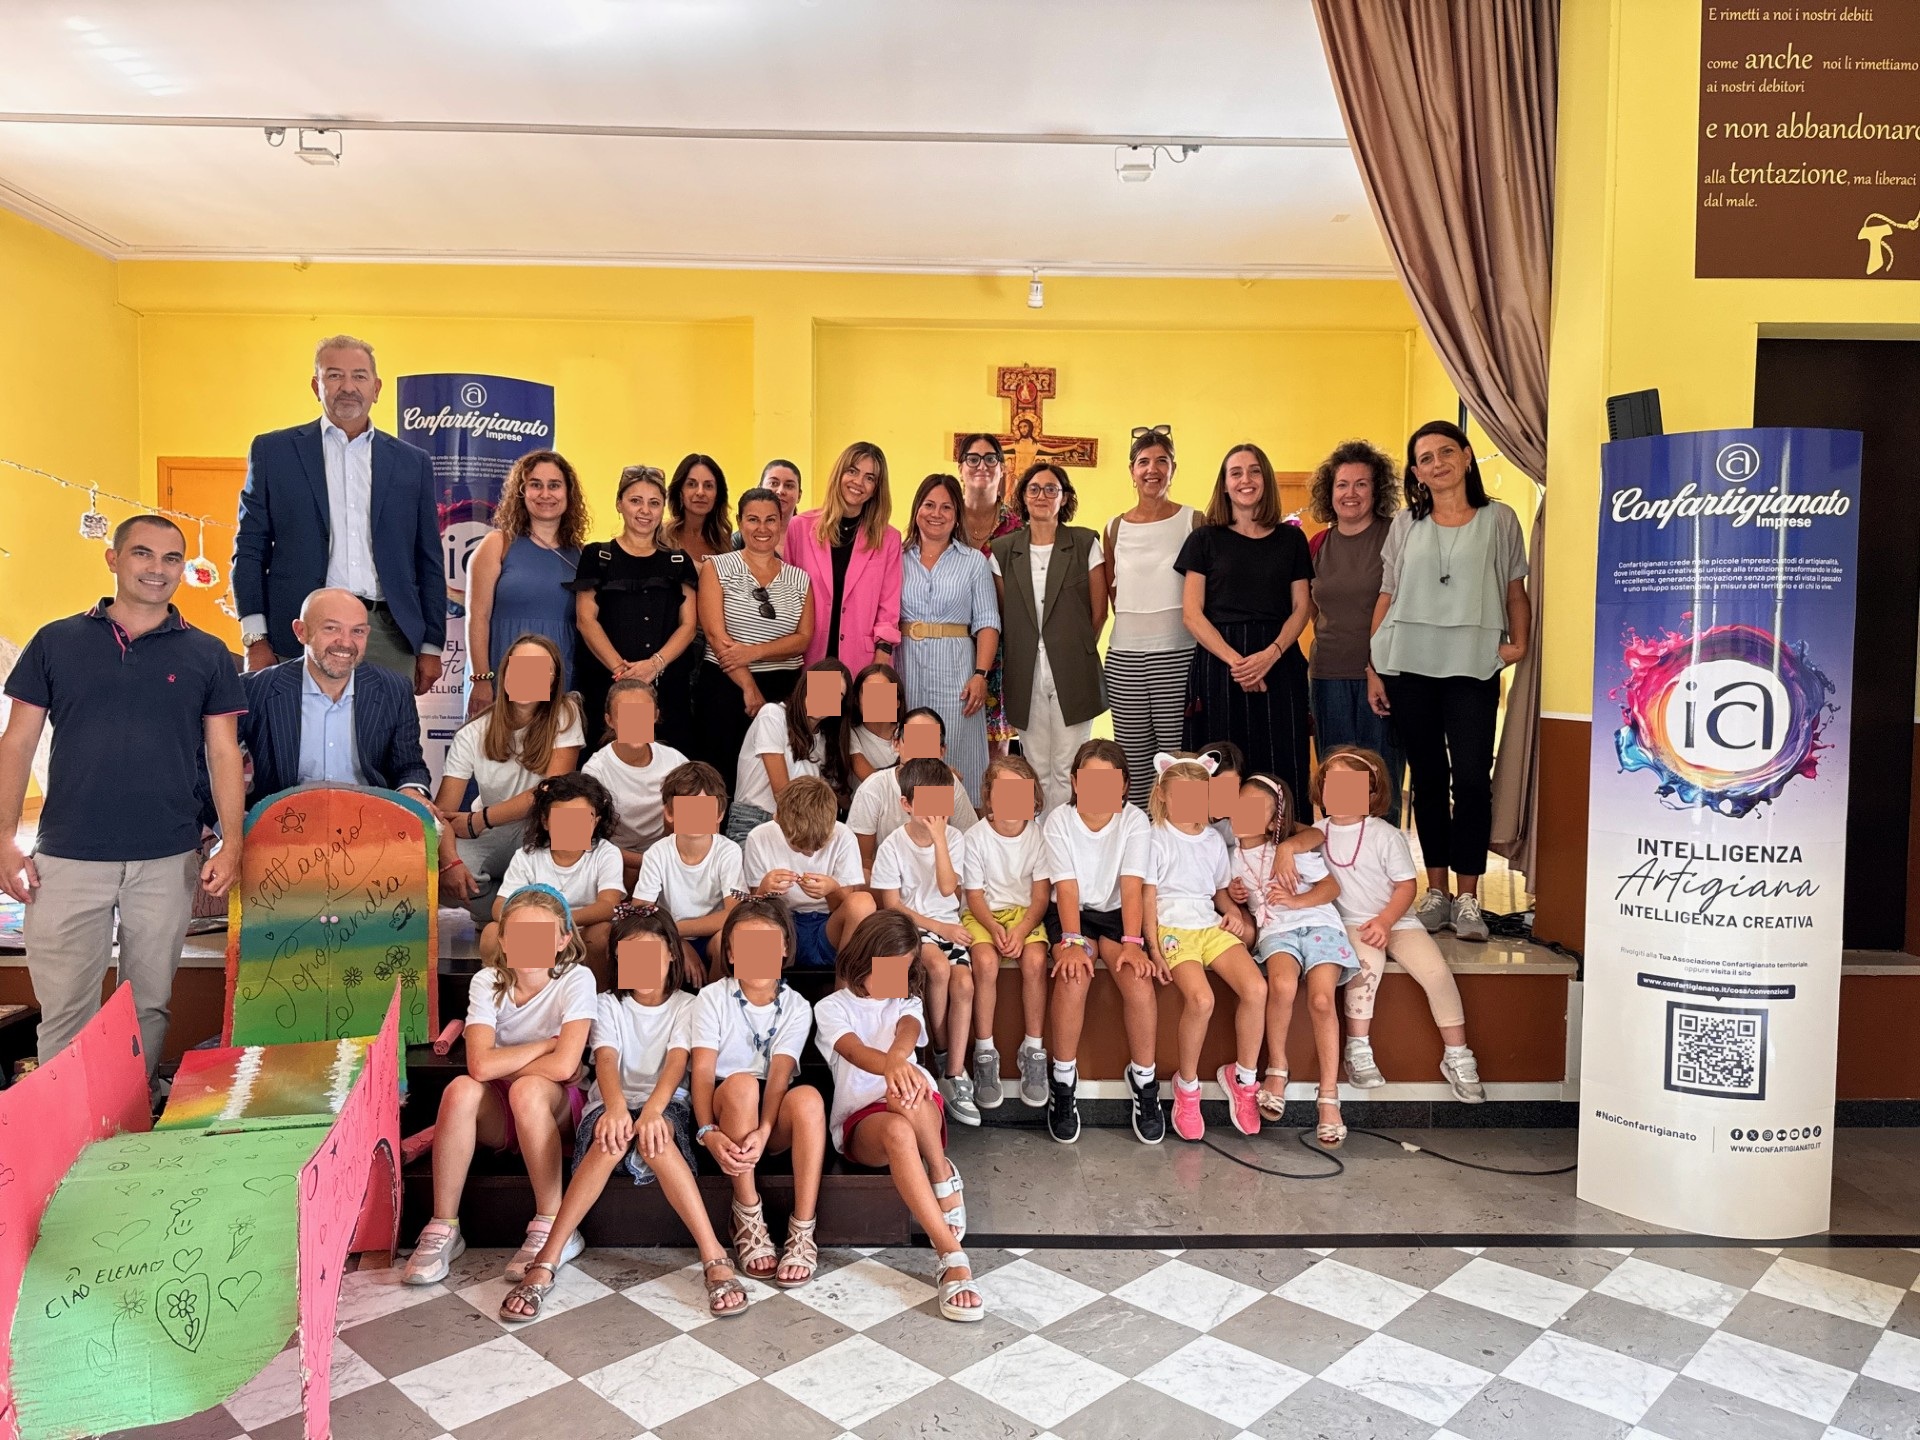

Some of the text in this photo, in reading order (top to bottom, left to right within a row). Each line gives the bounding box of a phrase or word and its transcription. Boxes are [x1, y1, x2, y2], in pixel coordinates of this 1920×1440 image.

[1709, 7, 1873, 22] E rimetti a noi i nostri debiti
[1707, 43, 1919, 71] come anche noi li rimettiamo
[1706, 78, 1805, 93] ai nostri debitori
[1706, 123, 1717, 139] e
[1724, 123, 1769, 139] non
[1704, 162, 1917, 187] alla tentazione, ma liberaci
[1704, 193, 1758, 208] dal male.
[404, 405, 549, 437] Confartigianato
[486, 430, 523, 442] Imprese
[1611, 483, 1849, 529] Confartigianato
[1756, 514, 1812, 528] Imprese
[1618, 561, 1668, 569] Confartigianato
[1669, 559, 1690, 567] crede
[1711, 557, 1739, 567] piccole
[1741, 557, 1770, 566] imprese
[1629, 568, 1666, 577] intelligenza
[1667, 566, 1697, 575] creativa
[1641, 584, 1669, 592] sviluppo
[1670, 583, 1712, 591] sostenbile,
[1799, 582, 1804, 590] di
[1658, 576, 1696, 584] generando
[1684, 681, 1774, 750] ia
[1637, 838, 1803, 863] INTELLIGENZA
[1614, 857, 1820, 913] Artigiana
[1620, 903, 1813, 929] INTELLIGENZA CREATIVA
[1620, 946, 1645, 957] Rivolgiti
[1659, 953, 1671, 961] Tua
[1672, 955, 1720, 966] Associazione
[1722, 960, 1776, 969] Confartigianato
[1684, 965, 1709, 973] oppure
[1595, 1109, 1697, 1141] #NoiConfartigianato
[1730, 1142, 1821, 1153] WWW.CONFARTIGIANATO.IT
[46, 1263, 149, 1319] CIAO ELENA
